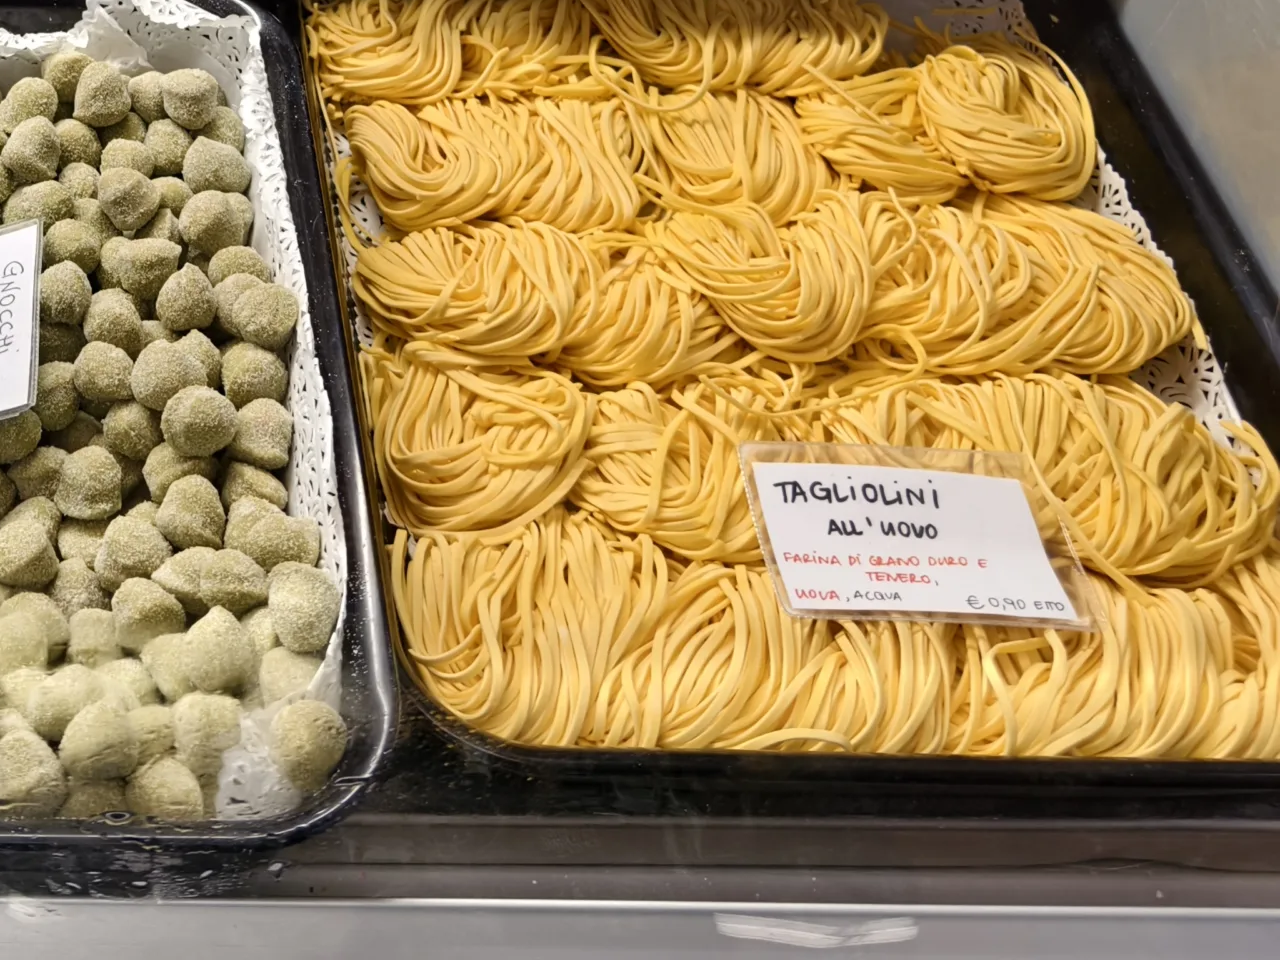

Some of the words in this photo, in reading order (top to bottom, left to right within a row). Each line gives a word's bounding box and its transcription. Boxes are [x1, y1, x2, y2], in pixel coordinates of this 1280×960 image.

[868, 554, 920, 568] GRANO
[928, 556, 969, 568] DURO
[978, 557, 988, 569] E
